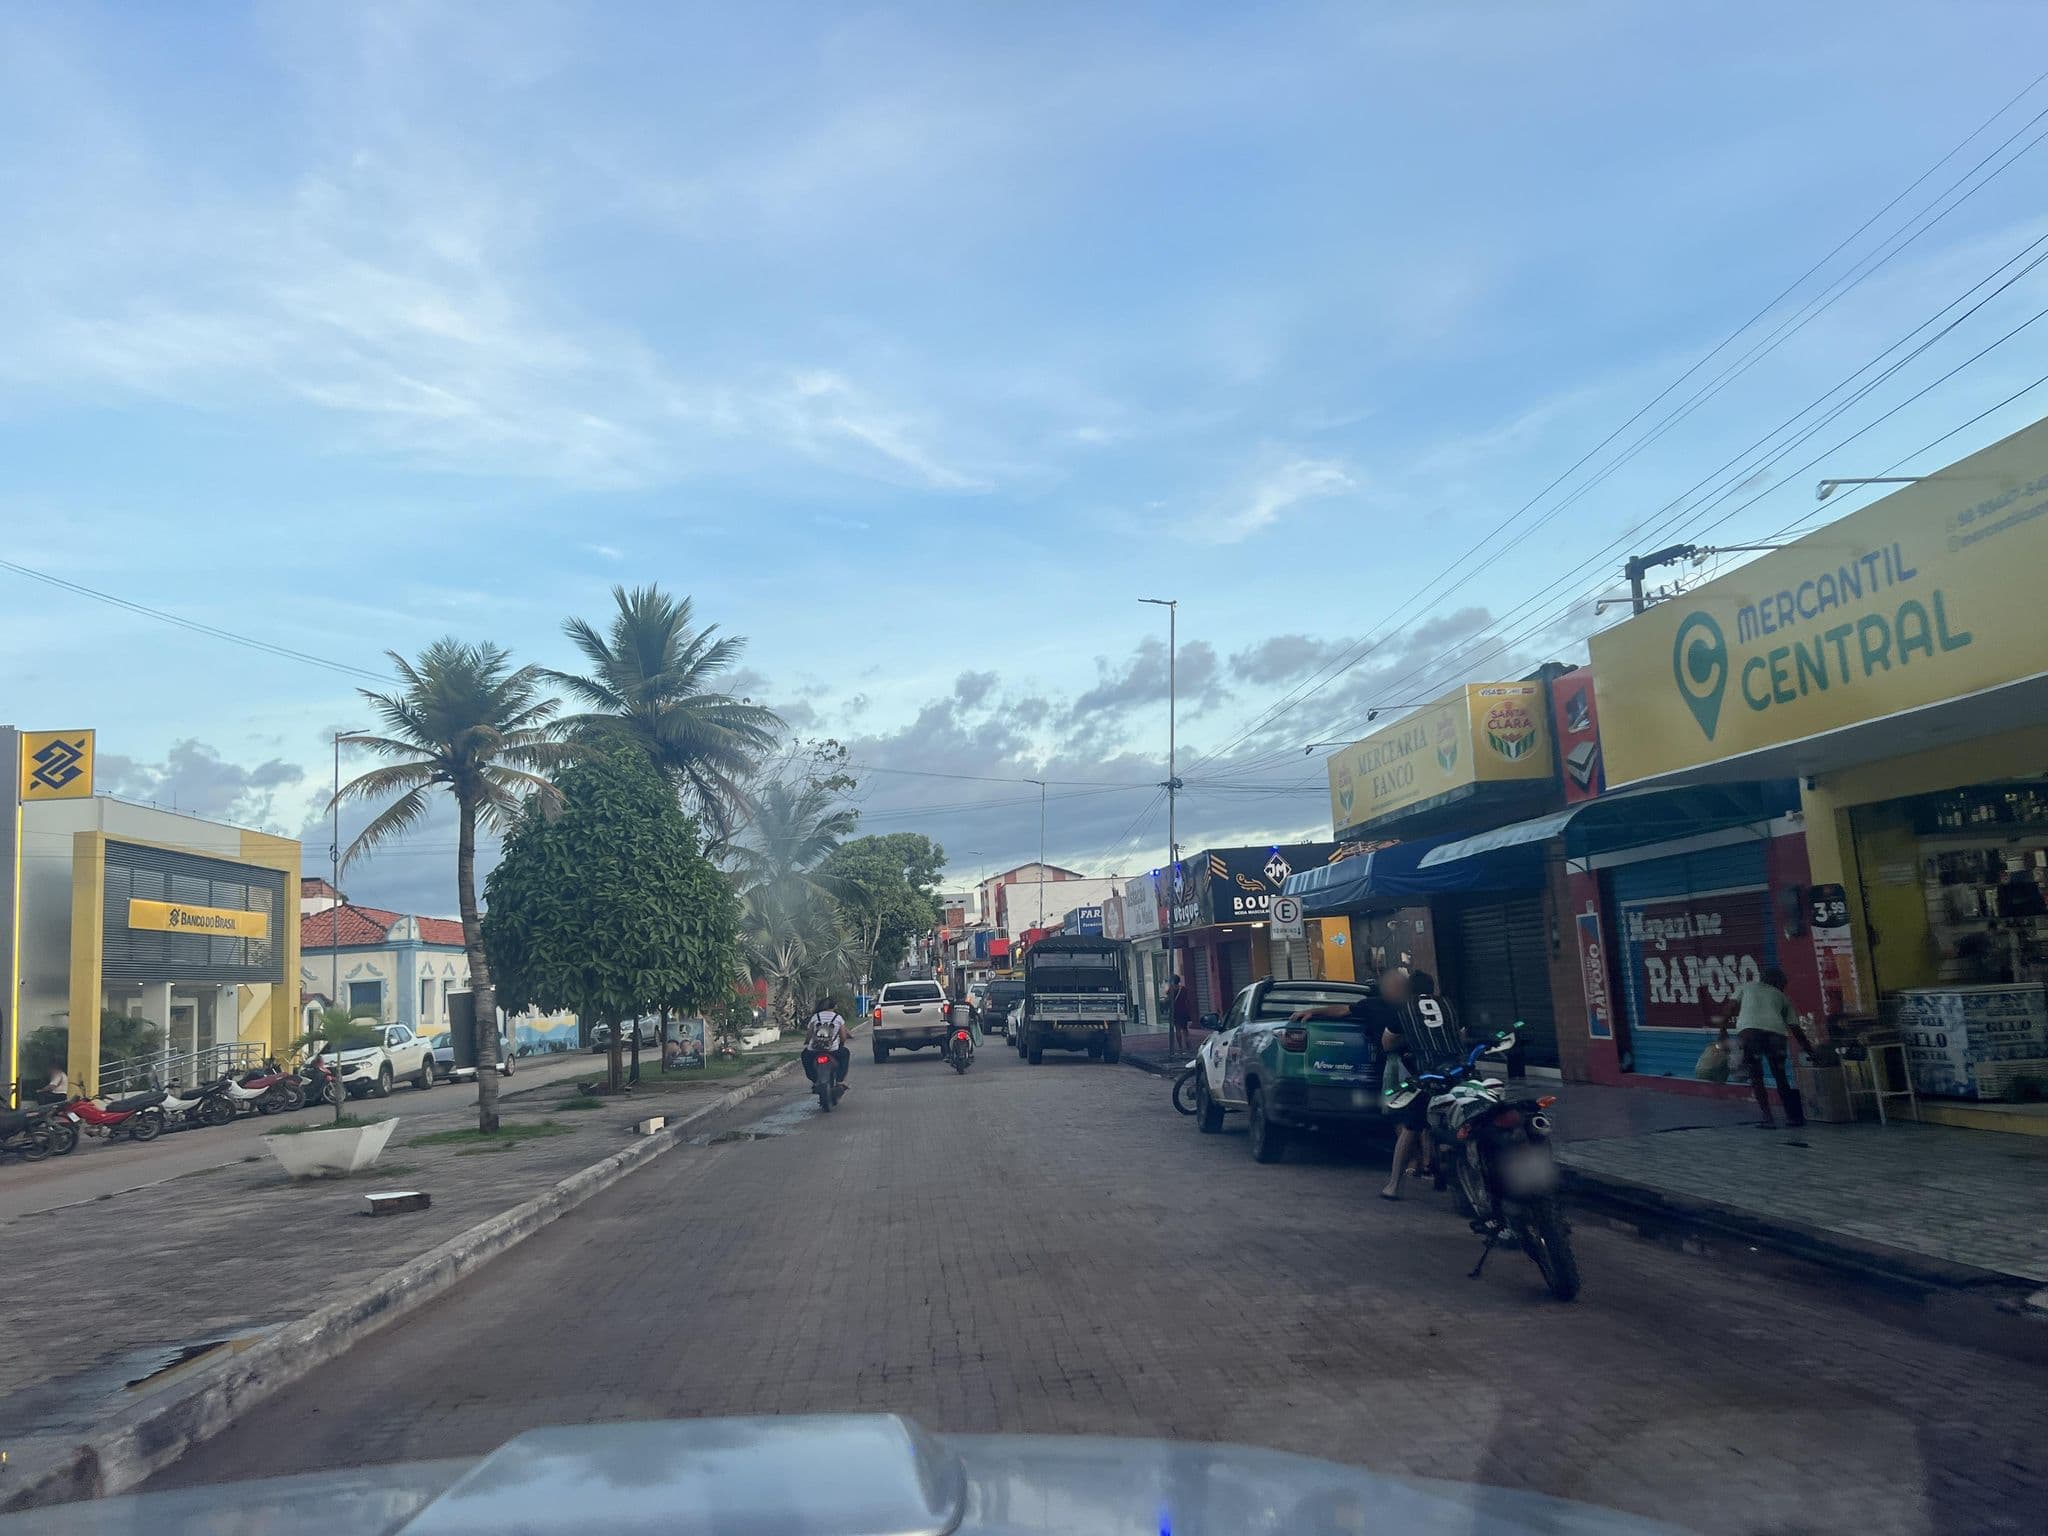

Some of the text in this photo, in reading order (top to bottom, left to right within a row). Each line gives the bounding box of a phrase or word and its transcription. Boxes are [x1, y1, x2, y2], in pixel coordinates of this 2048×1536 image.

[1737, 543, 1917, 645] MERCANTIL
[1742, 590, 1973, 712] CENTRAL
[1487, 718, 1533, 730] CLARA
[1491, 709, 1528, 719] SANTA
[1357, 725, 1428, 777] MERCEARIA
[1268, 863, 1288, 878] JM
[1233, 894, 1276, 911] BOU
[1281, 903, 1291, 919] E
[181, 911, 236, 930] BANCO DO BRASIL
[1628, 912, 1723, 951] Magazine
[1644, 954, 1761, 1003] RAPOSO
[1418, 998, 1443, 1028] 9
